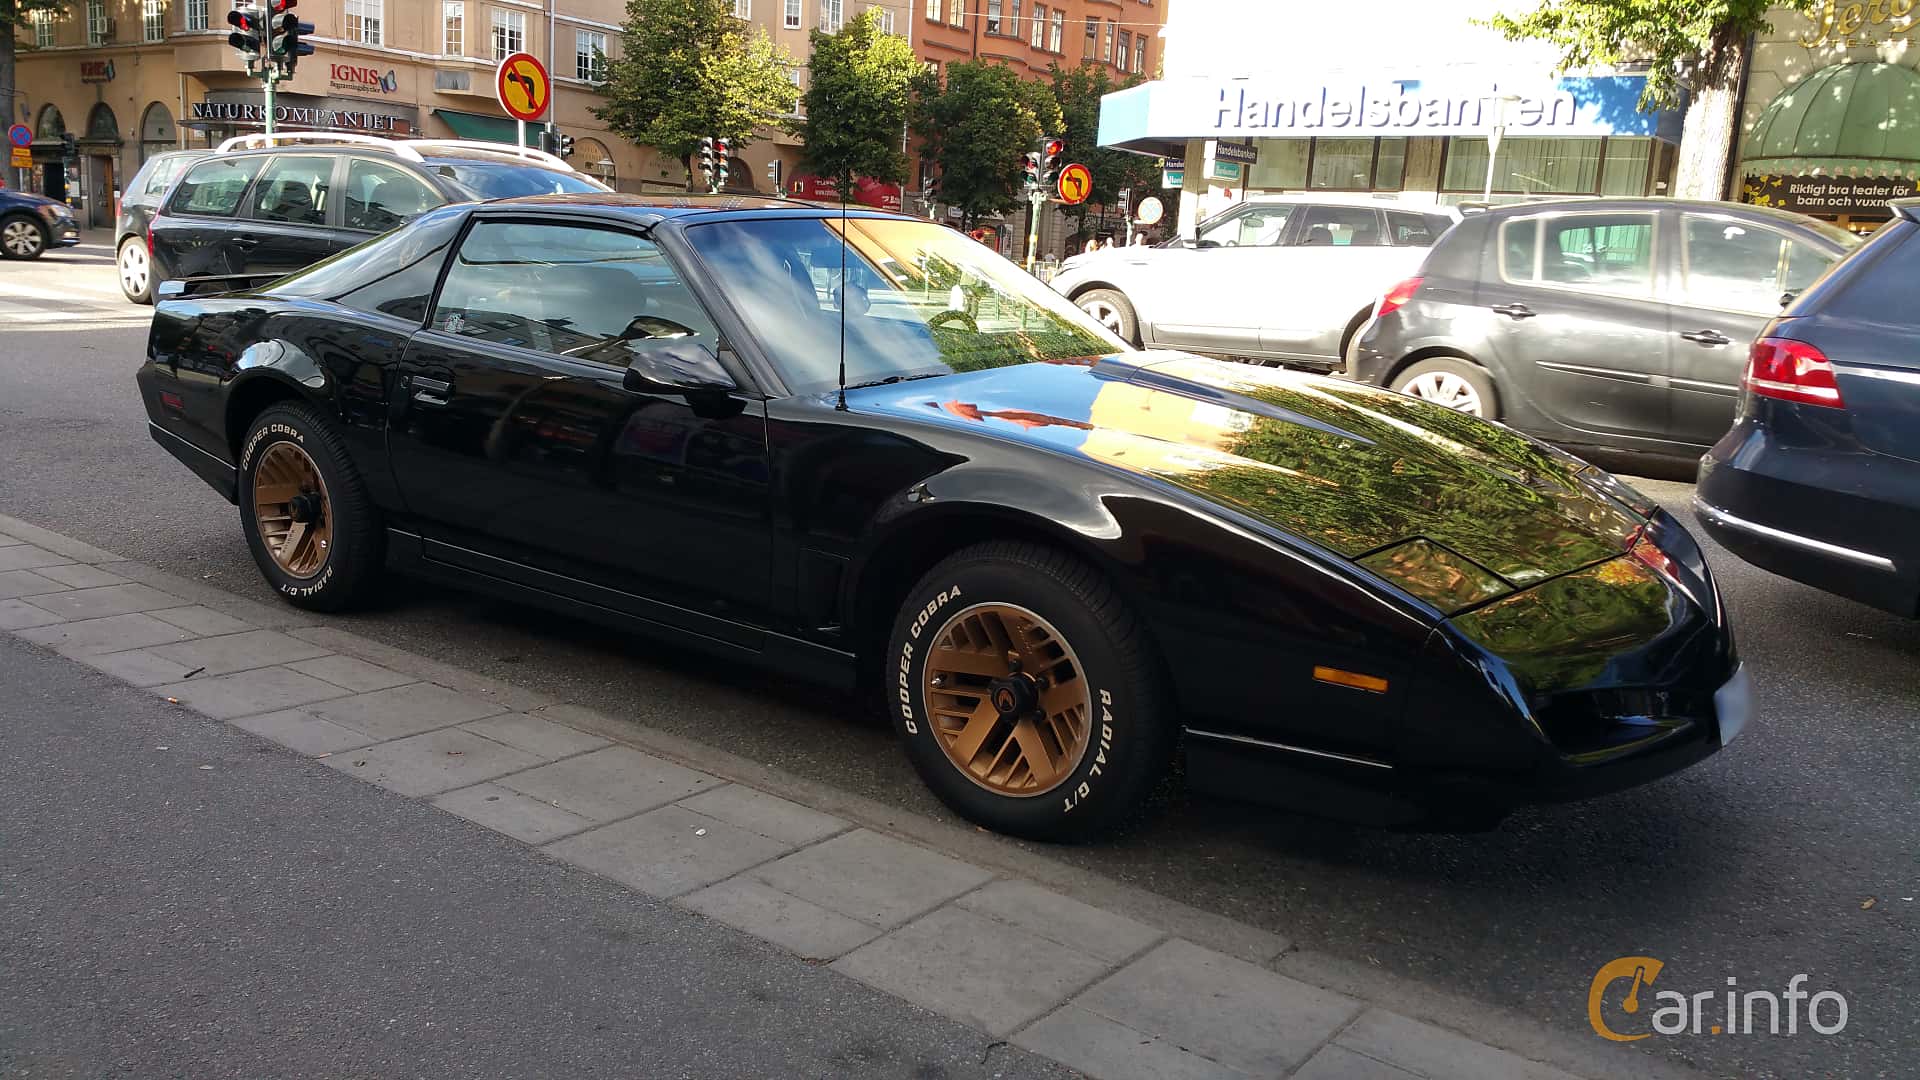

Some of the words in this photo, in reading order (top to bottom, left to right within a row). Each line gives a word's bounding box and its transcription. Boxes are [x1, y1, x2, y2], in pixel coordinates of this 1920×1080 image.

[330, 63, 378, 85] IGNIS
[191, 103, 399, 130] NATURKOMPANIET
[1789, 184, 1826, 196] Riktigt
[1828, 184, 1849, 195] bra
[1852, 185, 1890, 196] teater
[1892, 185, 1910, 197] för
[1796, 195, 1825, 206] barn
[1827, 196, 1852, 207] och
[242, 426, 269, 471] COOPER
[271, 423, 304, 443] COBRA
[899, 641, 918, 735] COOPER
[910, 585, 962, 639] COBRA
[1089, 688, 1113, 776] RADIAL
[1064, 781, 1090, 813] G/T
